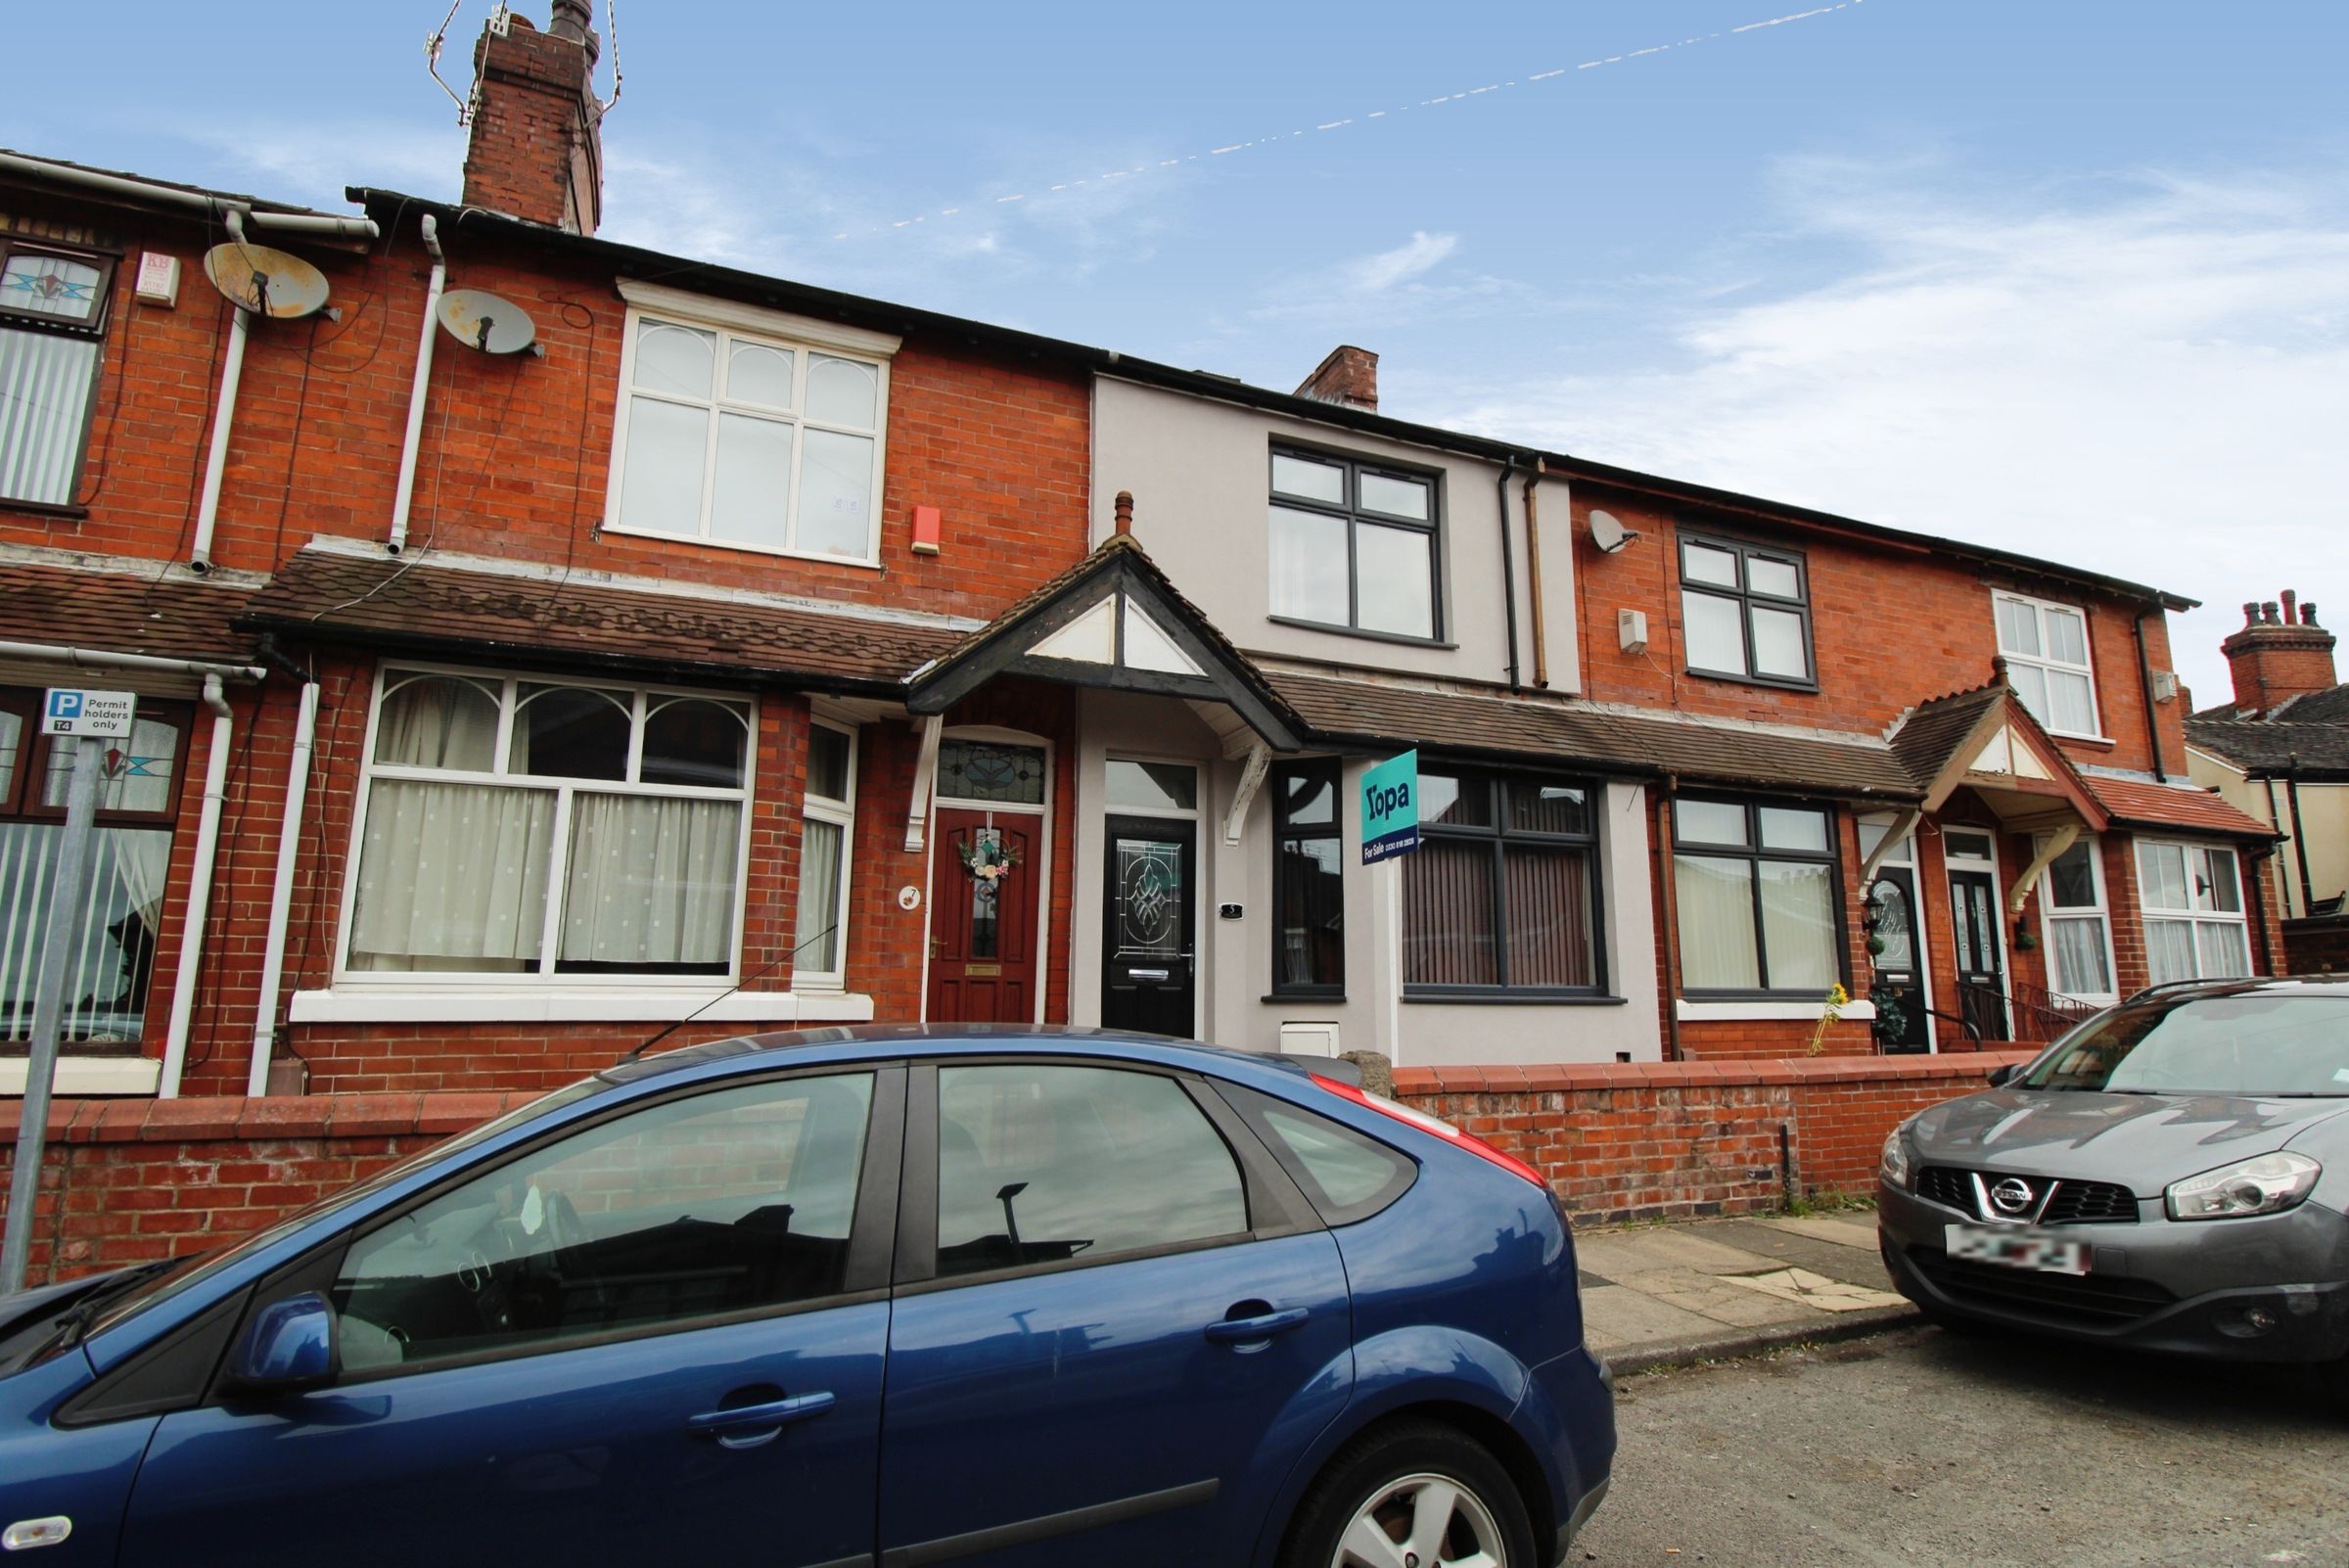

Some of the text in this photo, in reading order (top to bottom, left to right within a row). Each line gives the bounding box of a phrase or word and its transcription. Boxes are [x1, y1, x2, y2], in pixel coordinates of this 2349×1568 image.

[57, 694, 78, 715] P
[88, 699, 127, 709] Permit
[84, 710, 128, 719] holders
[56, 721, 70, 730] T4
[93, 720, 117, 730] only
[1365, 782, 1409, 821] Yopa
[1364, 848, 1373, 859] For
[1373, 842, 1384, 856] Sale
[911, 889, 916, 898] 7
